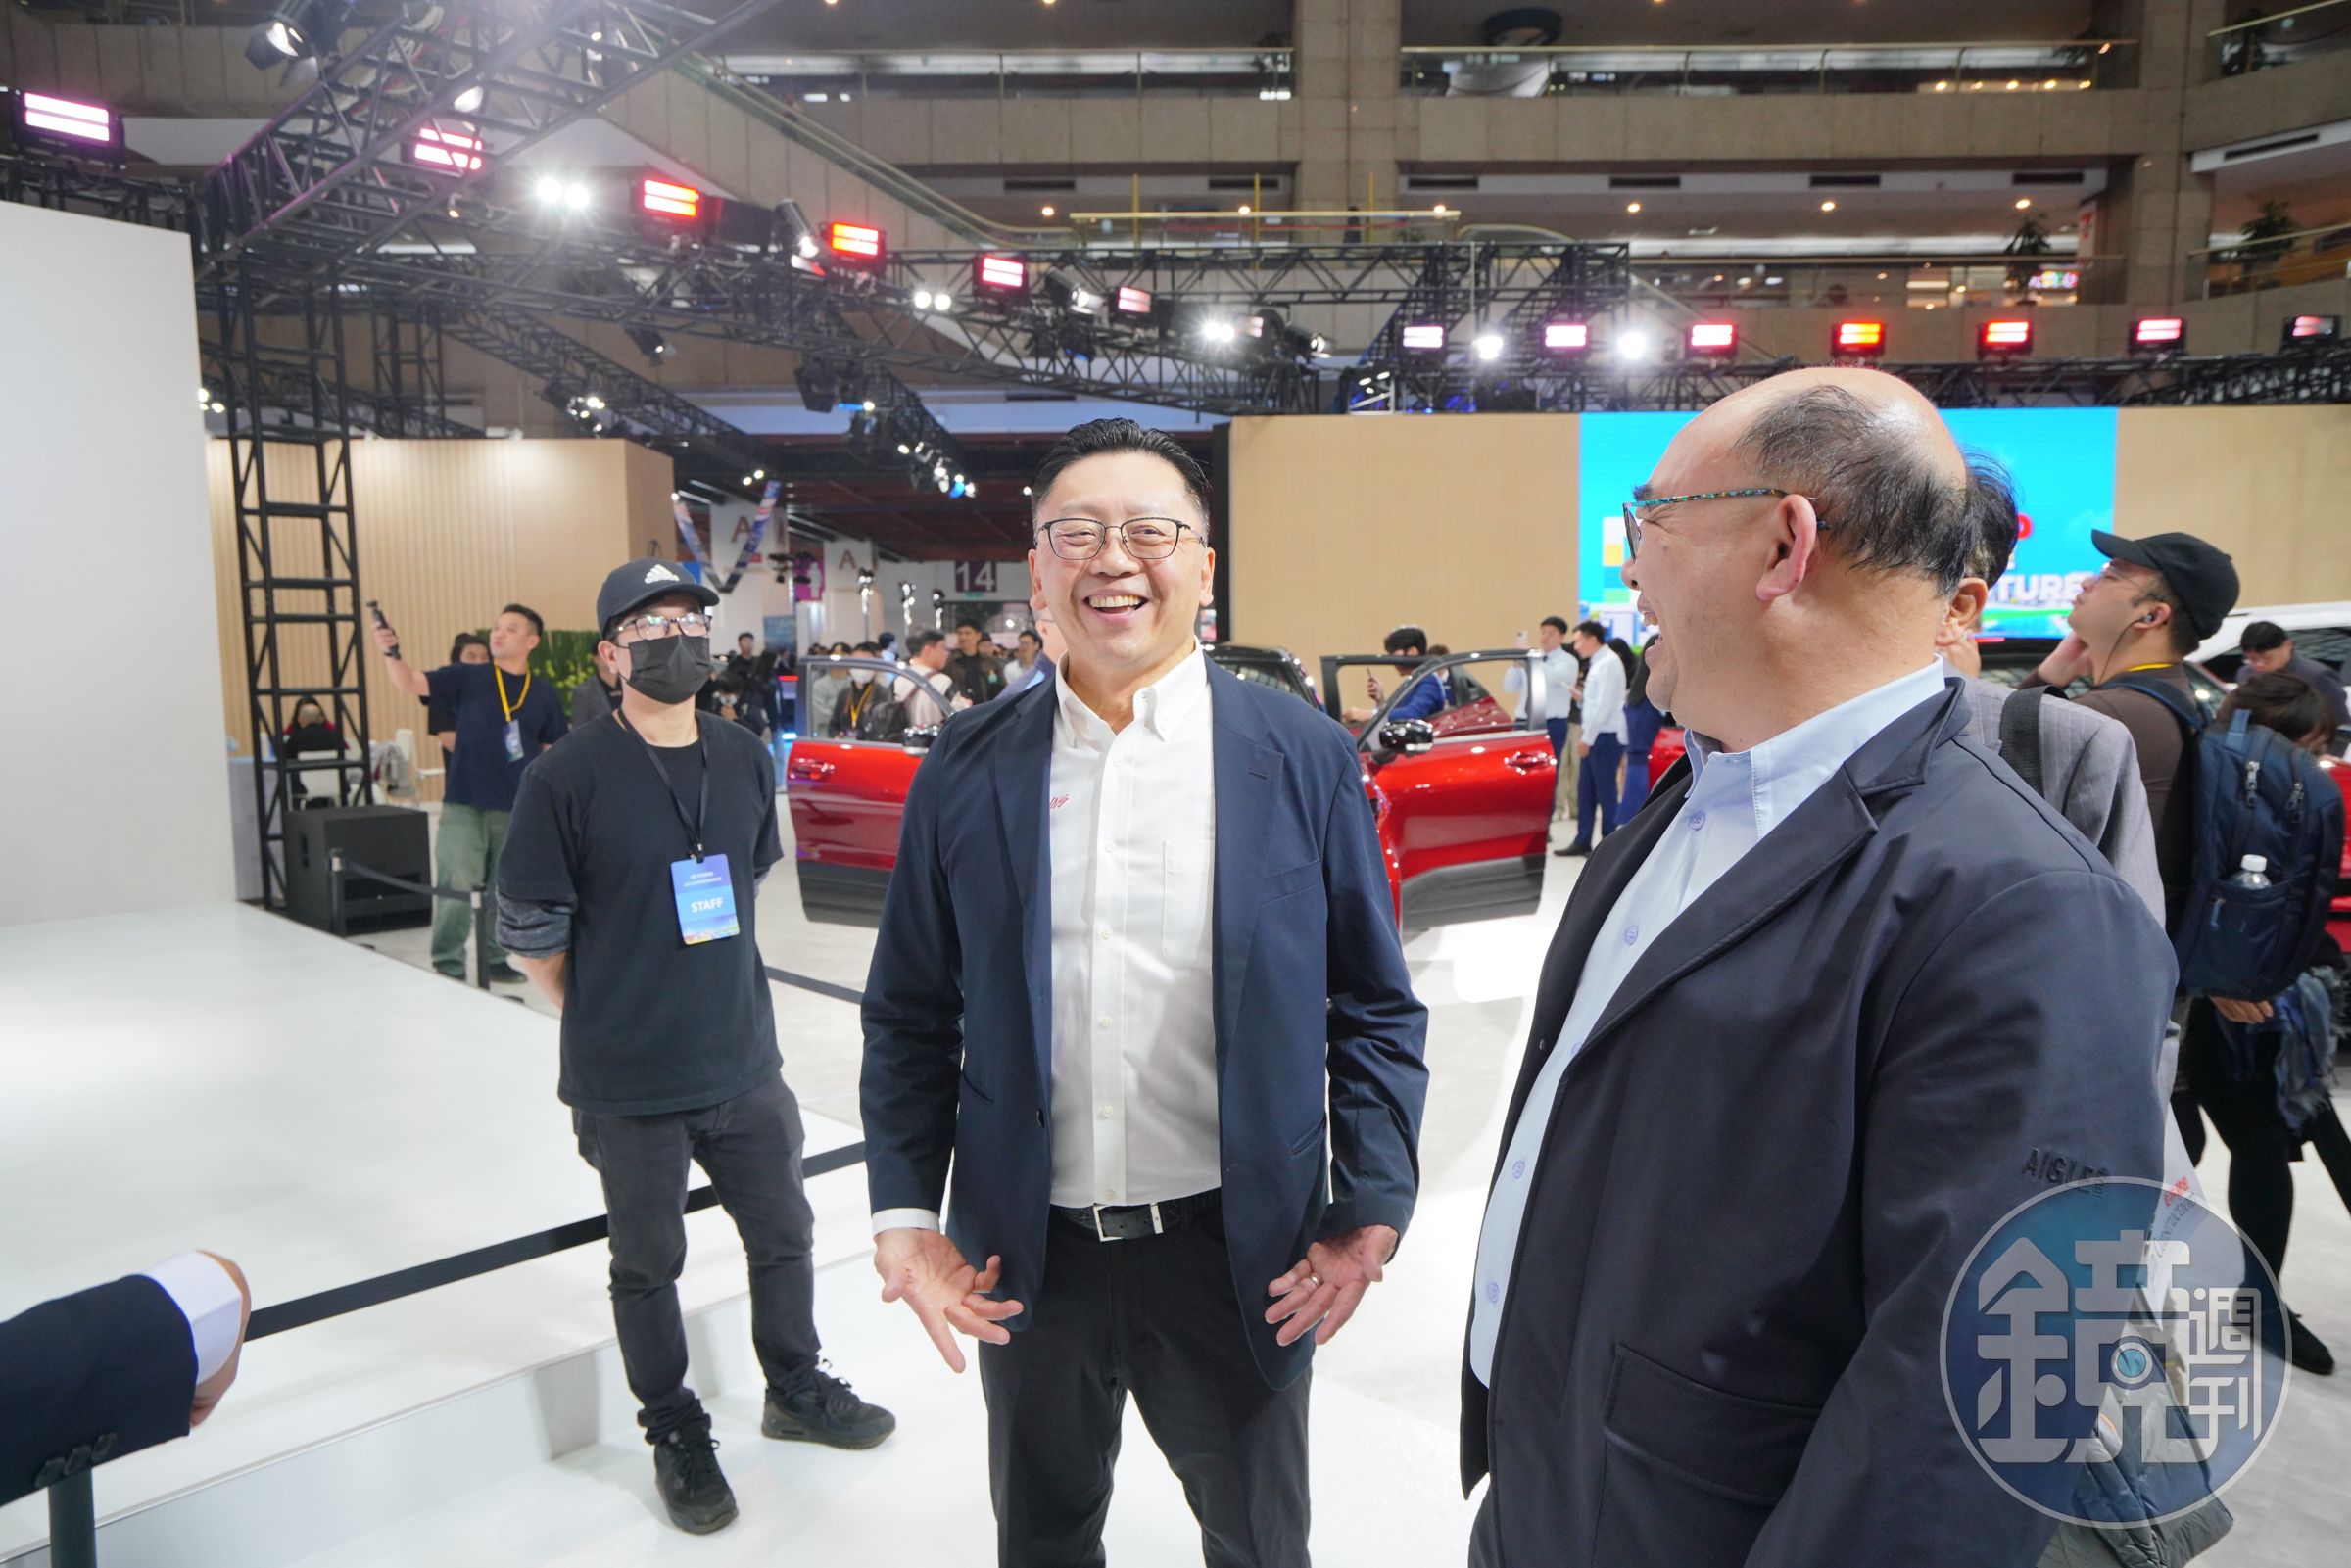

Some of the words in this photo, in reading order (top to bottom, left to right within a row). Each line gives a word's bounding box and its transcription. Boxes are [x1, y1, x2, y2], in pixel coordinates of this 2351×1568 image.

[732, 516, 750, 543] A
[839, 549, 856, 570] A
[956, 560, 995, 592] 14
[691, 896, 723, 914] STAFF
